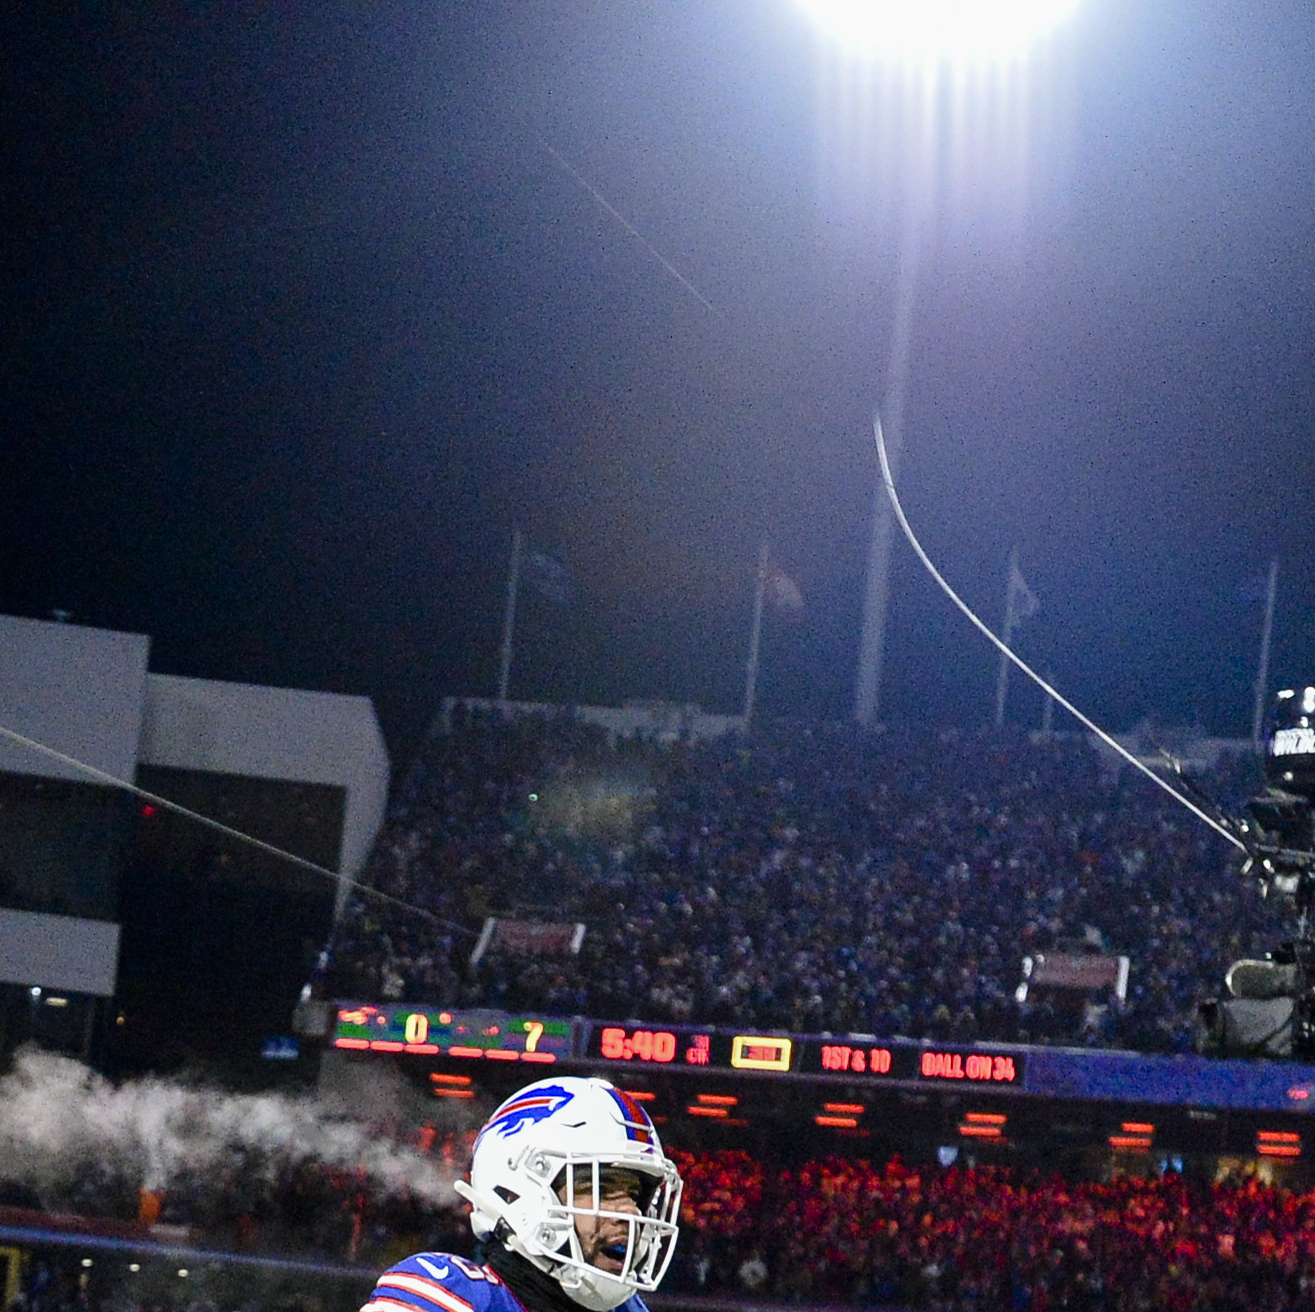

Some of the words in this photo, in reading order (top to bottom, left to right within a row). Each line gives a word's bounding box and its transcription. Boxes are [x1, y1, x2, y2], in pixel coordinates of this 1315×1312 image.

[404, 1013, 429, 1045] 0
[523, 1021, 544, 1053] 7
[601, 1027, 677, 1063] 5:40
